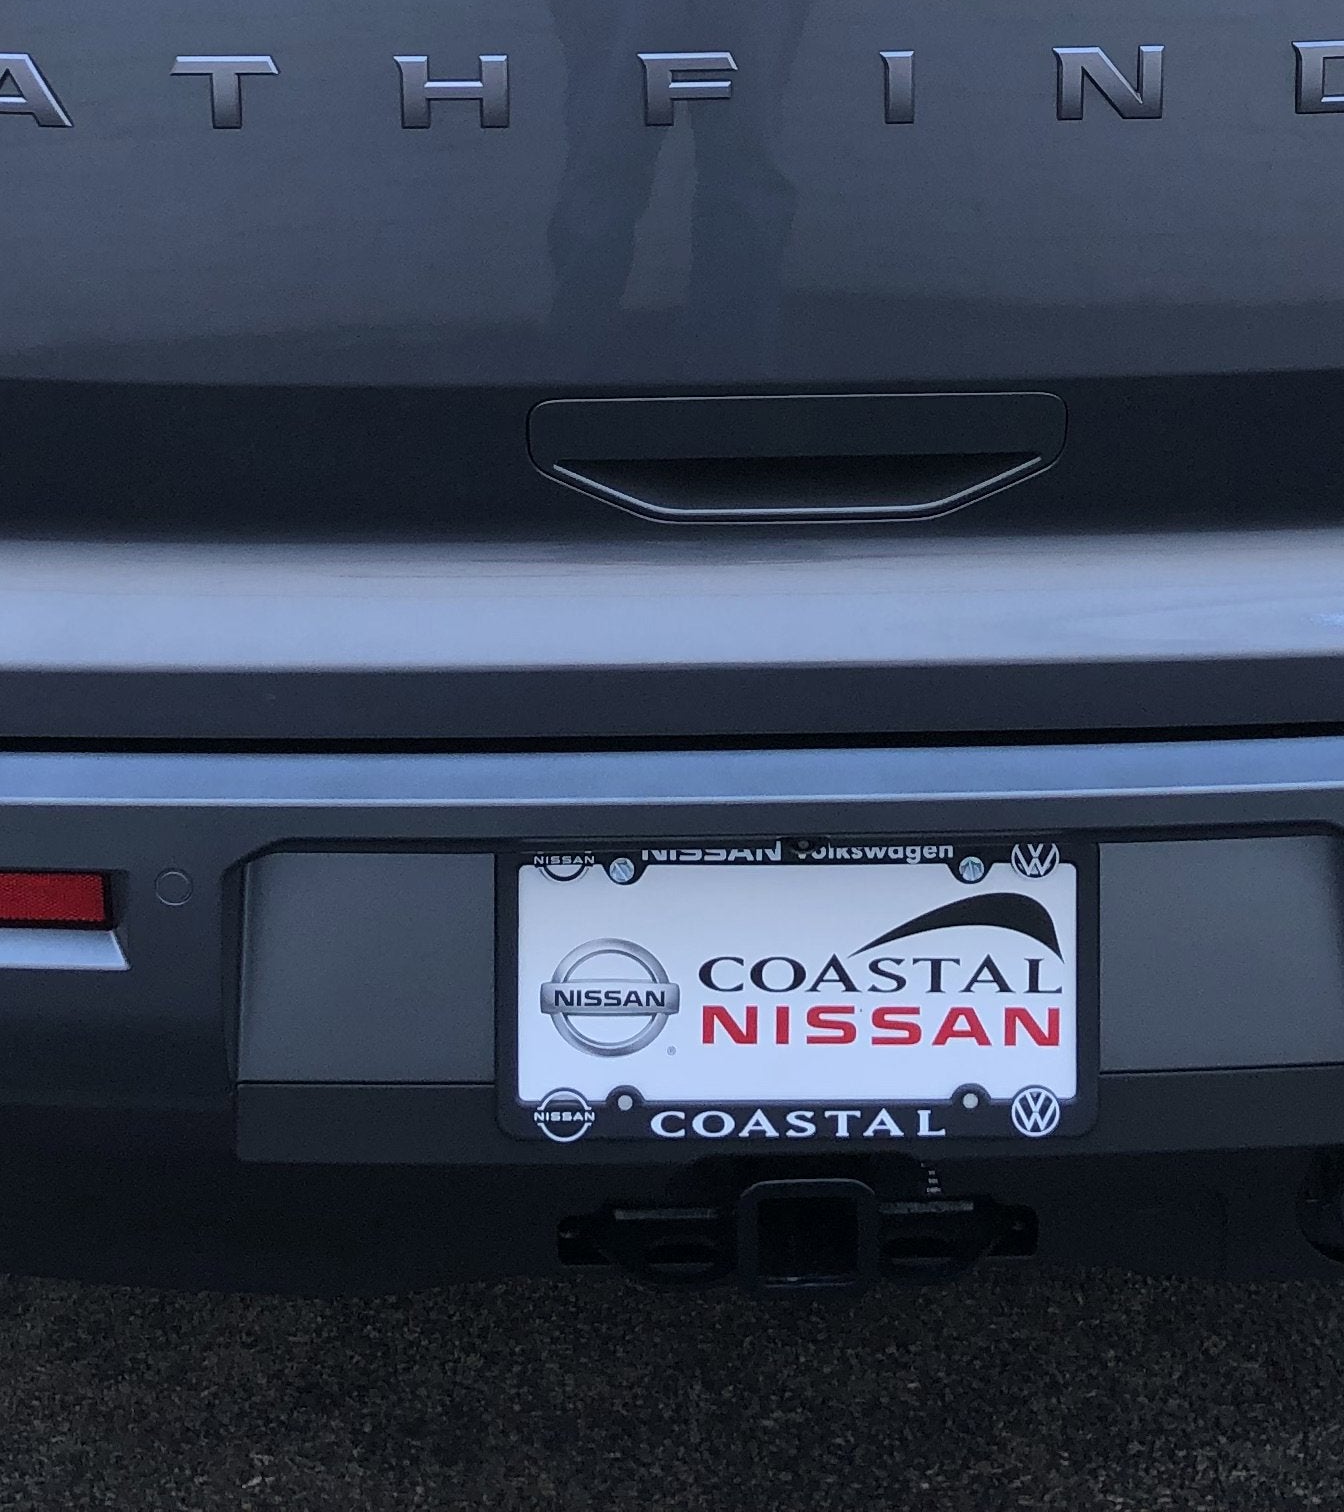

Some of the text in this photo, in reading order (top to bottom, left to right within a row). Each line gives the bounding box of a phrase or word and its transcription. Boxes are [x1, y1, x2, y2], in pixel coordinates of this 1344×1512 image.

[533, 855, 595, 865] NISSAN
[641, 841, 954, 865] NISSAN olkswagen
[698, 954, 1064, 994] COASTAL
[554, 989, 667, 1009] NISSAN
[701, 1005, 1061, 1047] NISSAN
[533, 1110, 596, 1123] NISSAN
[650, 1109, 946, 1137] COASTAL
